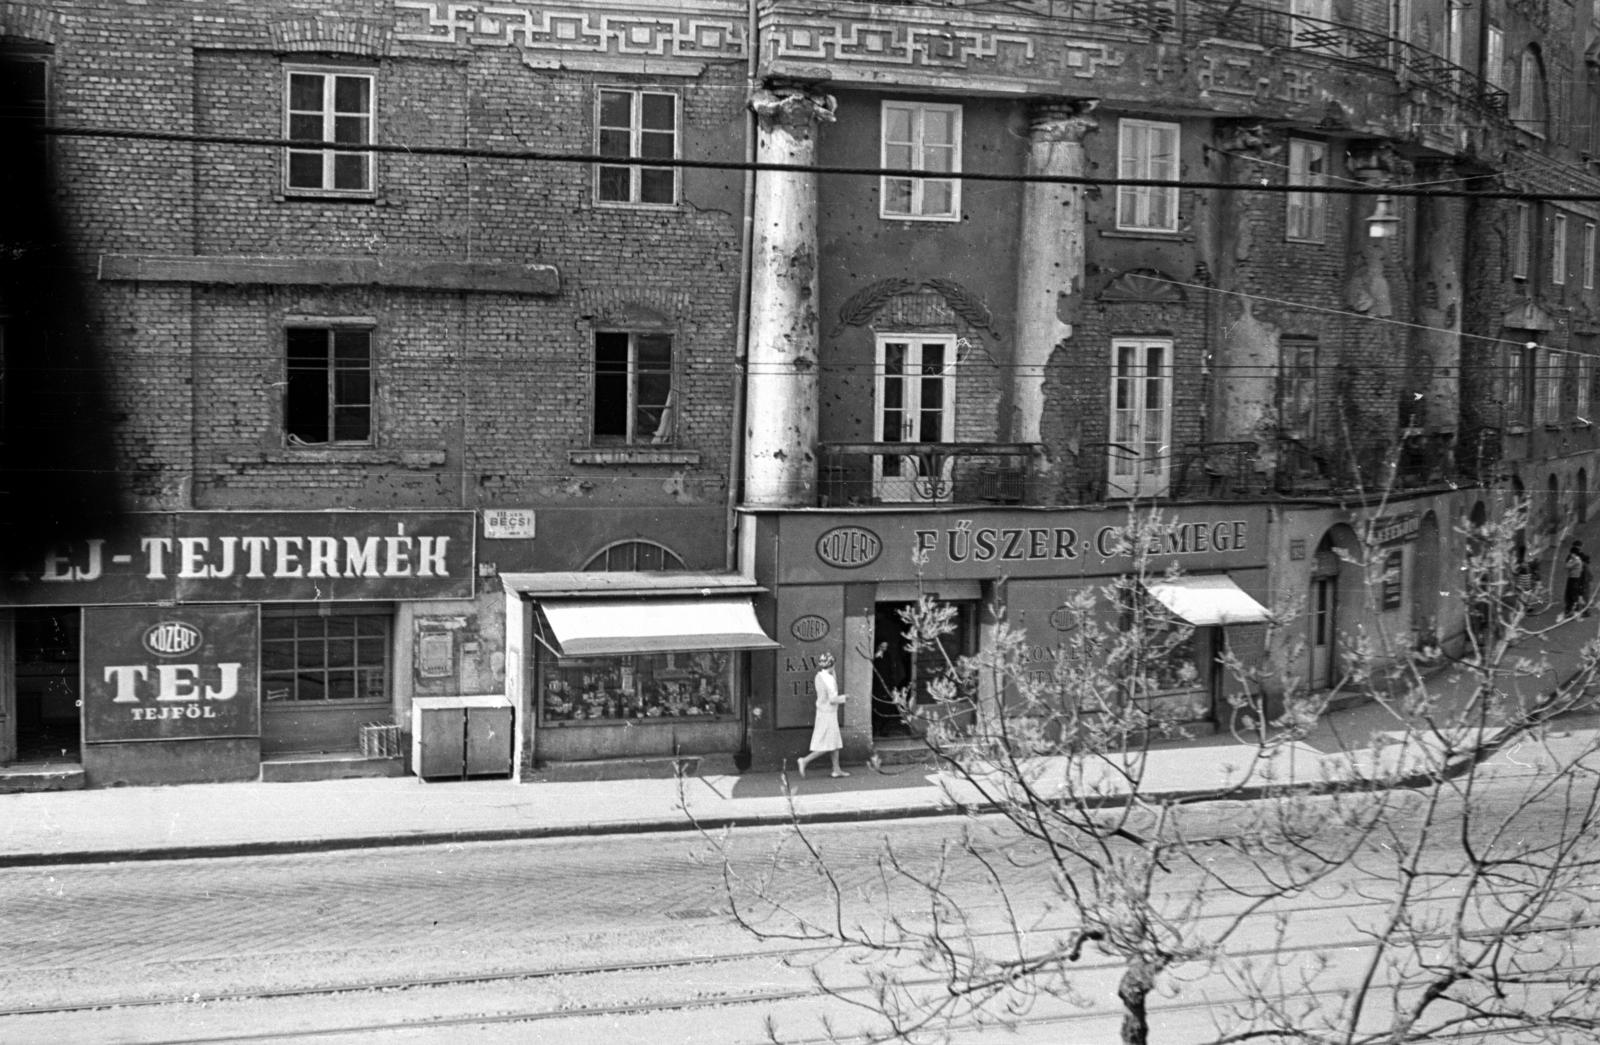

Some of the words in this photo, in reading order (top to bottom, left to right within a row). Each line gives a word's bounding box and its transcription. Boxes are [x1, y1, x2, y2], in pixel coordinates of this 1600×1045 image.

[10, 537, 107, 582] EJ
[141, 522, 450, 579] TEJTERMÉK
[915, 520, 1079, 563] FŰSZER
[104, 662, 242, 702] TEJ
[131, 703, 216, 720] TEJFÖL
